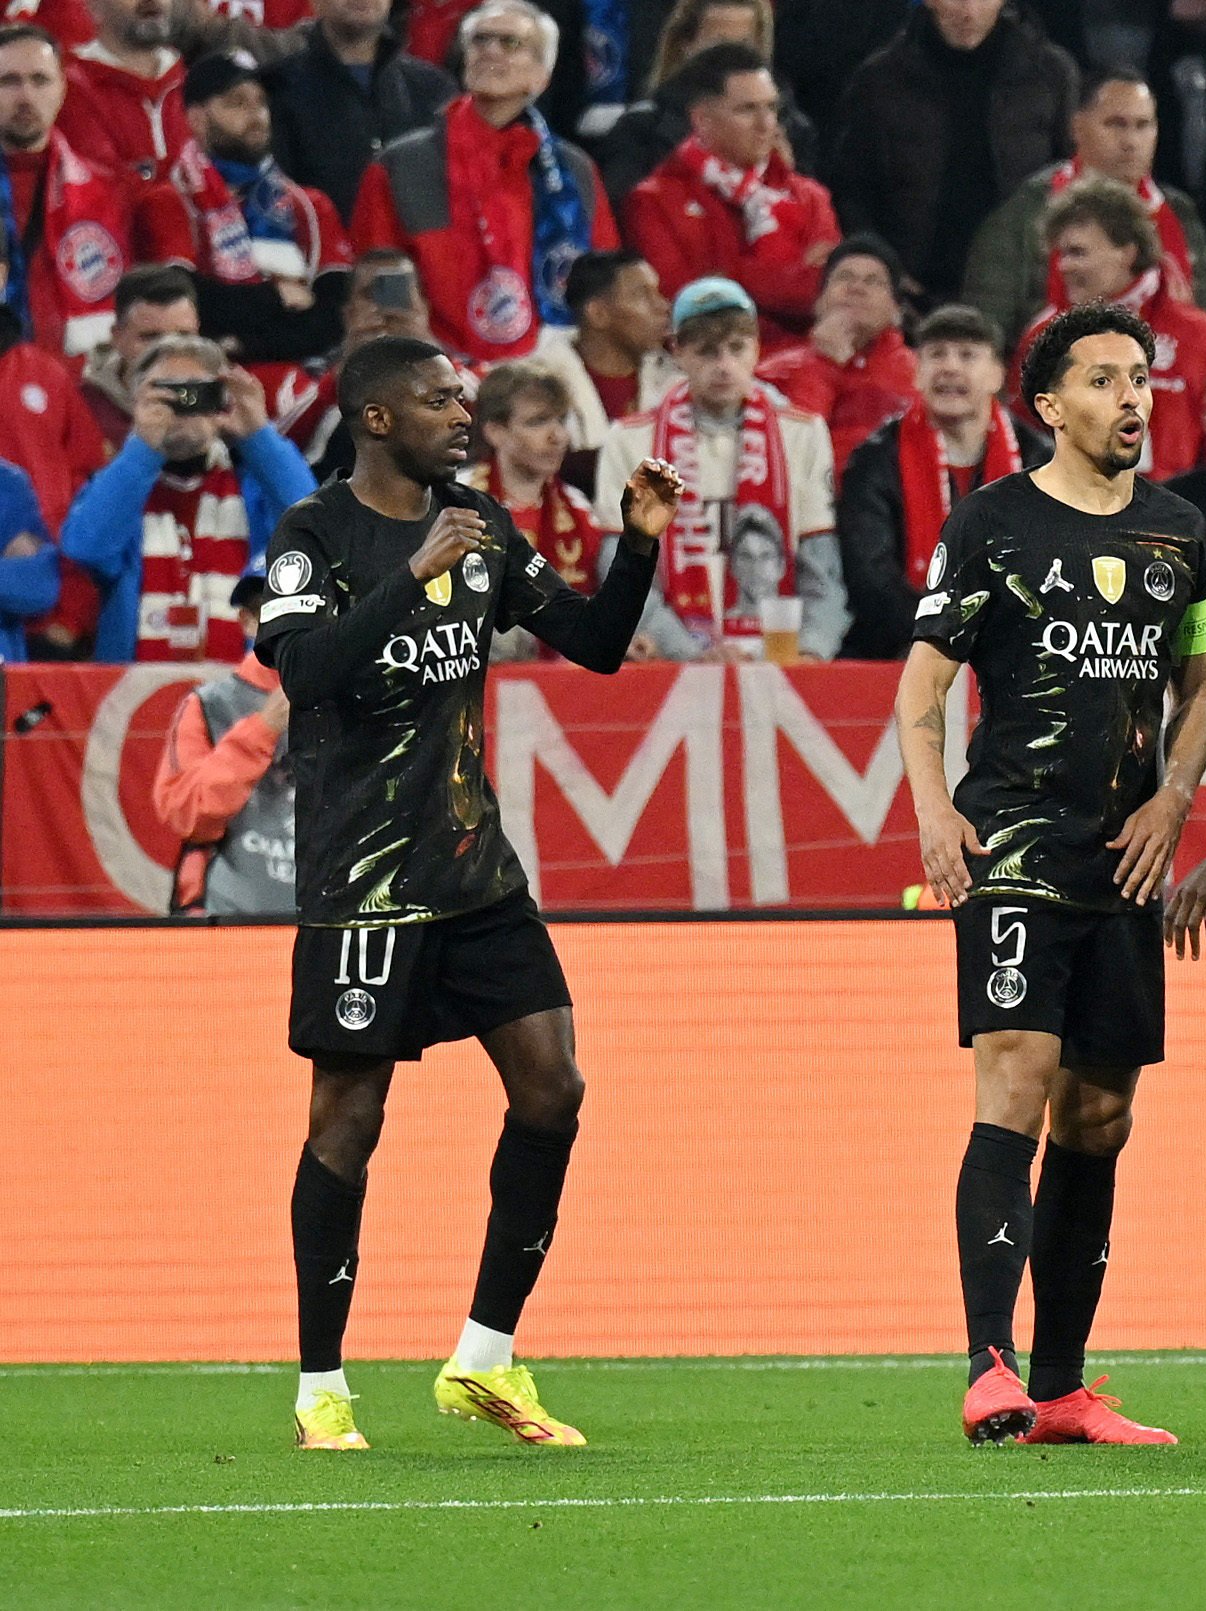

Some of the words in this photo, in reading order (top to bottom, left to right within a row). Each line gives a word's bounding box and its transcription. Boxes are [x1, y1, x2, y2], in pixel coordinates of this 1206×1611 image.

[1042, 620, 1163, 663] QATAR
[1078, 658, 1159, 680] AIRWAYS
[334, 926, 396, 986] 10
[991, 906, 1029, 967] 5
